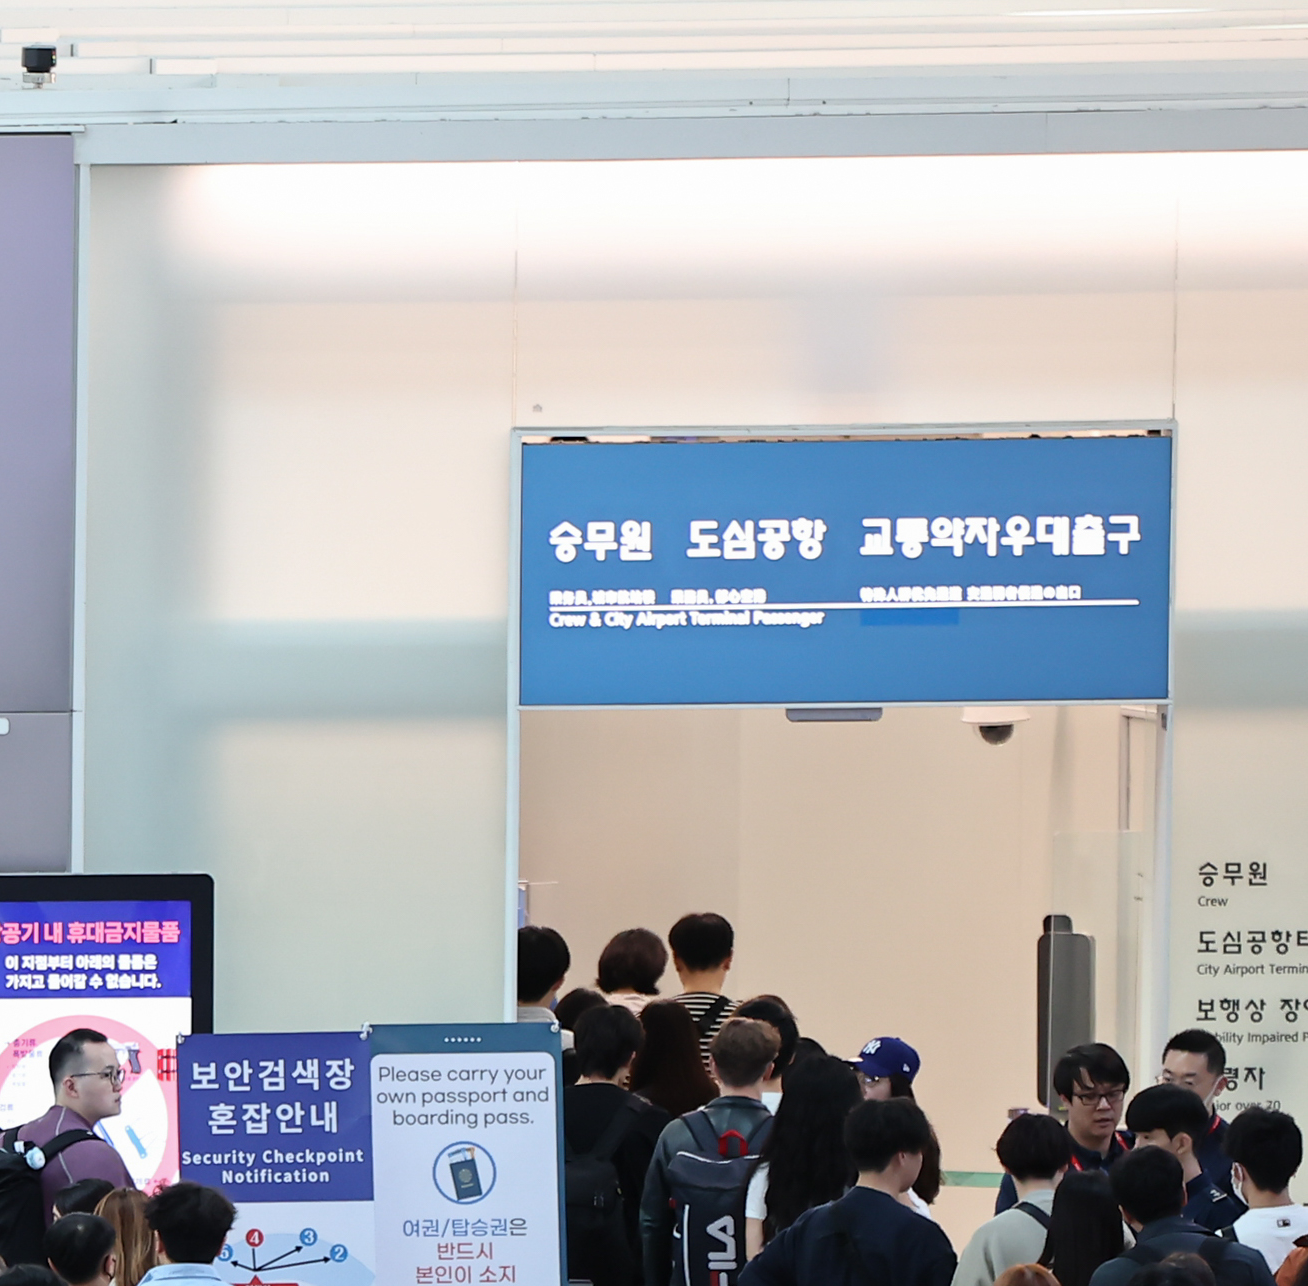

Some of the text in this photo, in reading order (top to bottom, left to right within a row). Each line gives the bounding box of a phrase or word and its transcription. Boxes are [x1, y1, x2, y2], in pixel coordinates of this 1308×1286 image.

[548, 514, 1142, 563] 승무원 도심공항 교통약자우대출구
[549, 610, 825, 630] Crew & City Airport Terminal Passenger
[1198, 861, 1268, 887] 승무원
[1197, 896, 1228, 907] Crew
[44, 922, 63, 944] 내
[67, 921, 180, 944] 휴대금지물품
[4, 955, 19, 970] 이
[21, 955, 74, 970] 지점부터
[75, 955, 115, 970] 아래의
[1197, 964, 1220, 977] City
[1223, 963, 1265, 977] Airport
[5, 975, 45, 990] 가지고
[89, 974, 104, 990] 수
[105, 973, 162, 989] 없습니다.
[1196, 998, 1266, 1023] 보행상
[1247, 1032, 1299, 1045] Impaired
[190, 1058, 355, 1093] 보안검색장
[378, 1066, 547, 1085] Please carry your
[376, 1086, 549, 1107] own passport and
[207, 1101, 339, 1135] 혼잡안내
[393, 1110, 534, 1129] boarding pass.
[182, 1148, 364, 1166] Security Checkpoint
[222, 1169, 330, 1184] Notification
[304, 1230, 313, 1244] 3
[403, 1217, 528, 1238] 여권/탑승권은
[250, 1231, 260, 1245] 4
[335, 1247, 345, 1260] 2
[437, 1241, 494, 1261] 반드시
[415, 1265, 516, 1284] 본인이 소지
